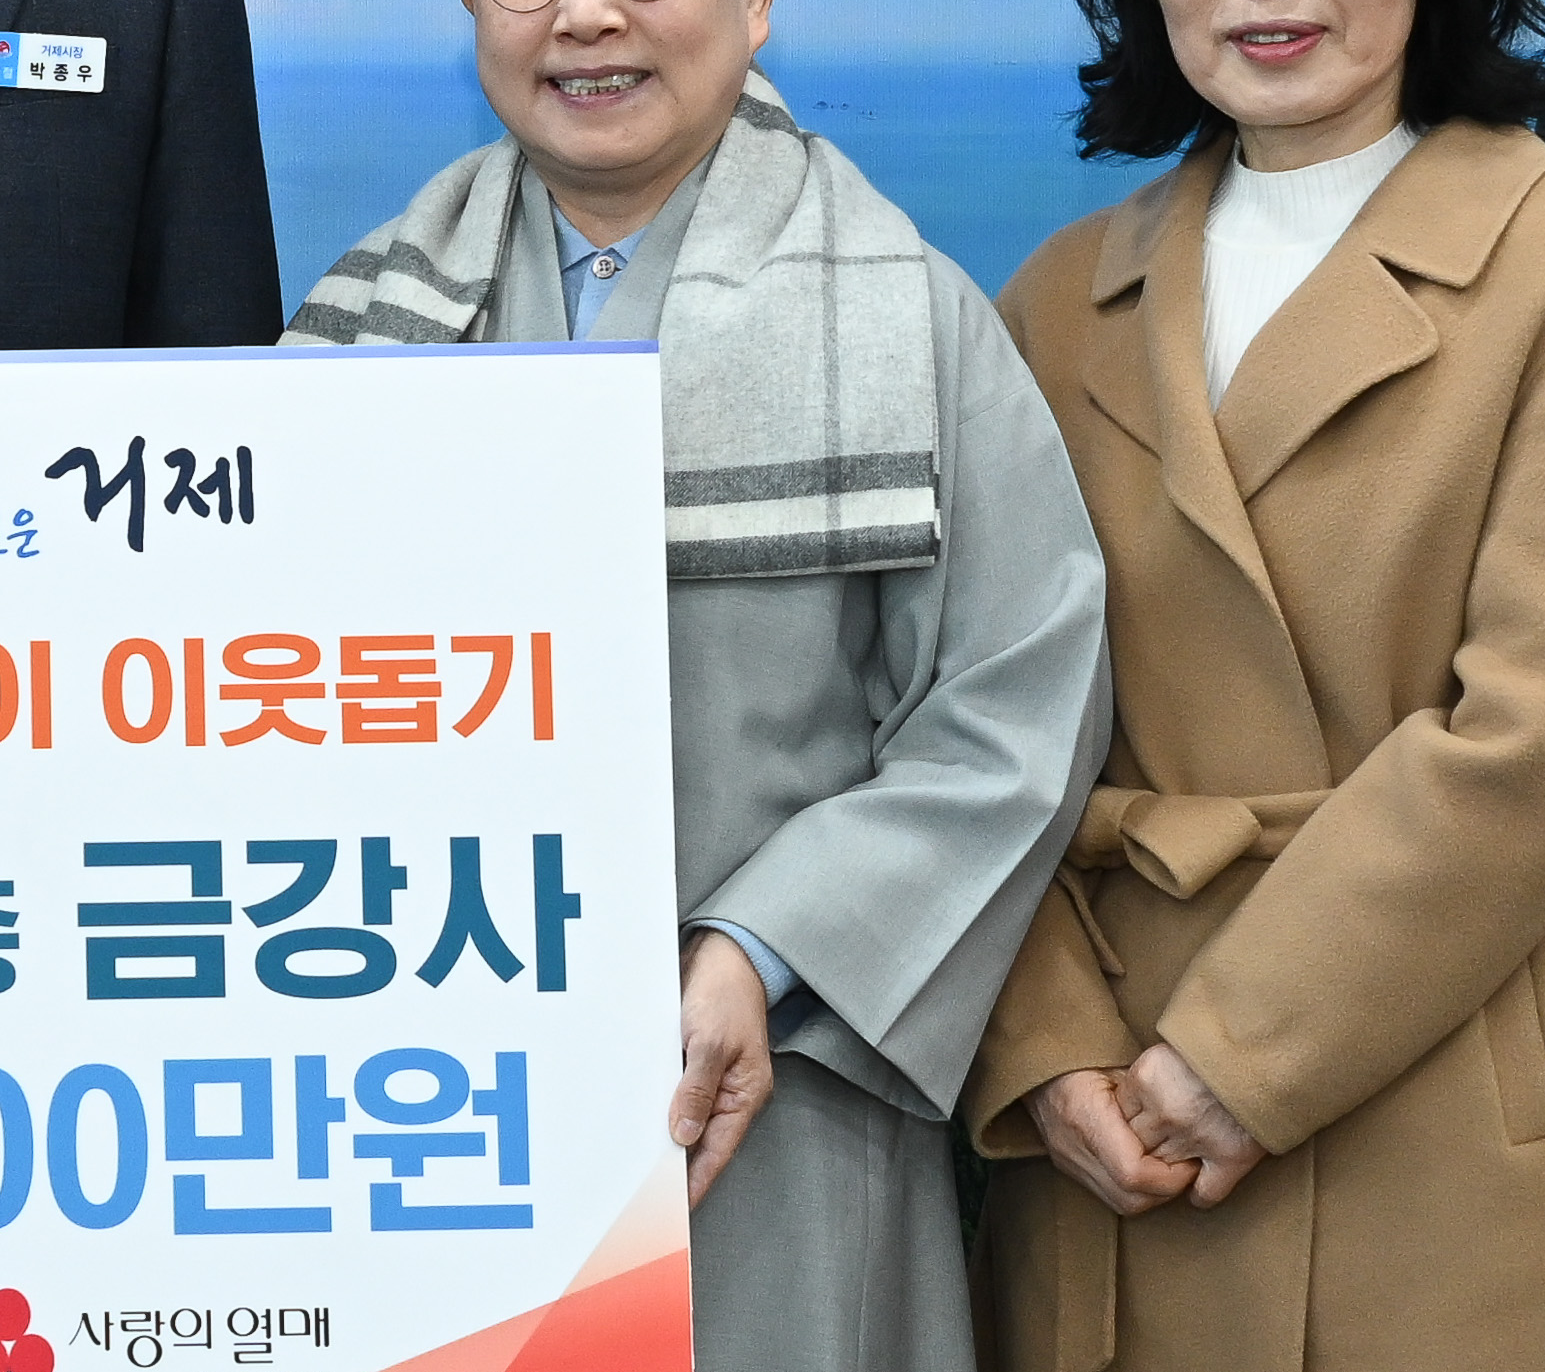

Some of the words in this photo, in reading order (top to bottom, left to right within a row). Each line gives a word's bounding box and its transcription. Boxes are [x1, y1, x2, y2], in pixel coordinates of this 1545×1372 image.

[42, 45, 83, 59] 거제시장
[45, 436, 256, 552] 거제
[102, 632, 556, 749] 이웃돕기
[77, 833, 581, 1000] 금강사
[69, 1309, 212, 1369] 사랑의
[227, 1308, 331, 1365] 열매
